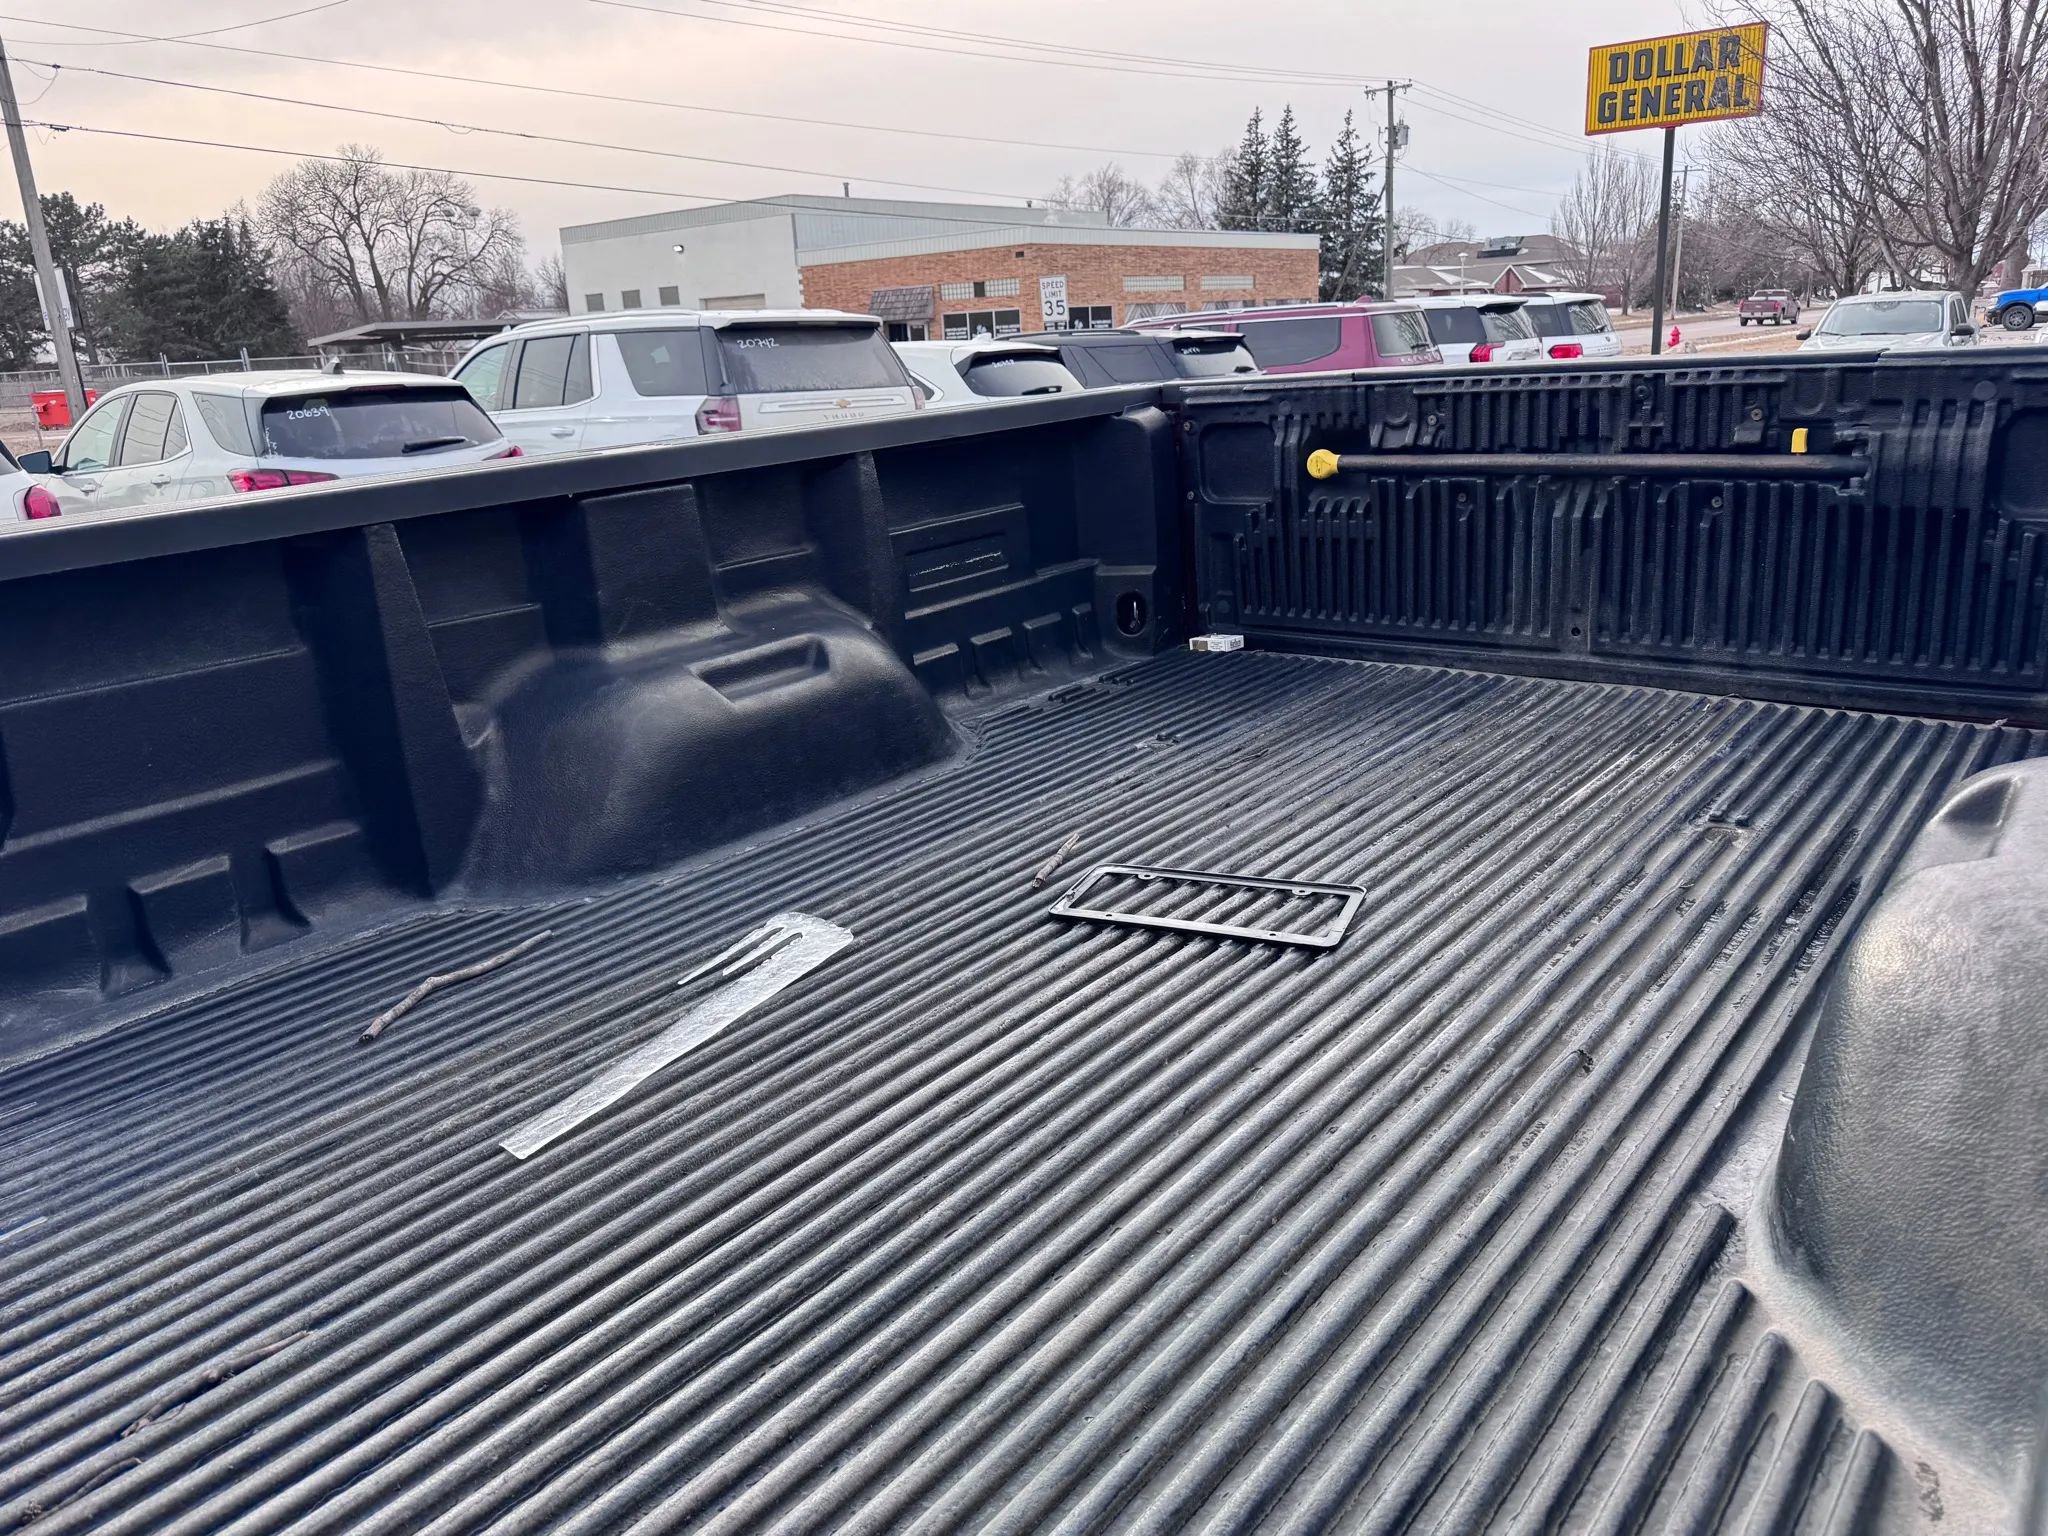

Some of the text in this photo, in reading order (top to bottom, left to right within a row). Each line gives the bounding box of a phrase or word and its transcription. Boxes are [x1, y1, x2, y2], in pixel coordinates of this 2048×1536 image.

[1609, 35, 1741, 85] DOLLAR
[1597, 74, 1750, 124] GENERAL
[1041, 281, 1064, 290] SPEED
[1044, 290, 1062, 299] LIMIT
[1044, 300, 1066, 317] 35
[736, 337, 780, 349] 20742
[286, 406, 330, 420] 20639
